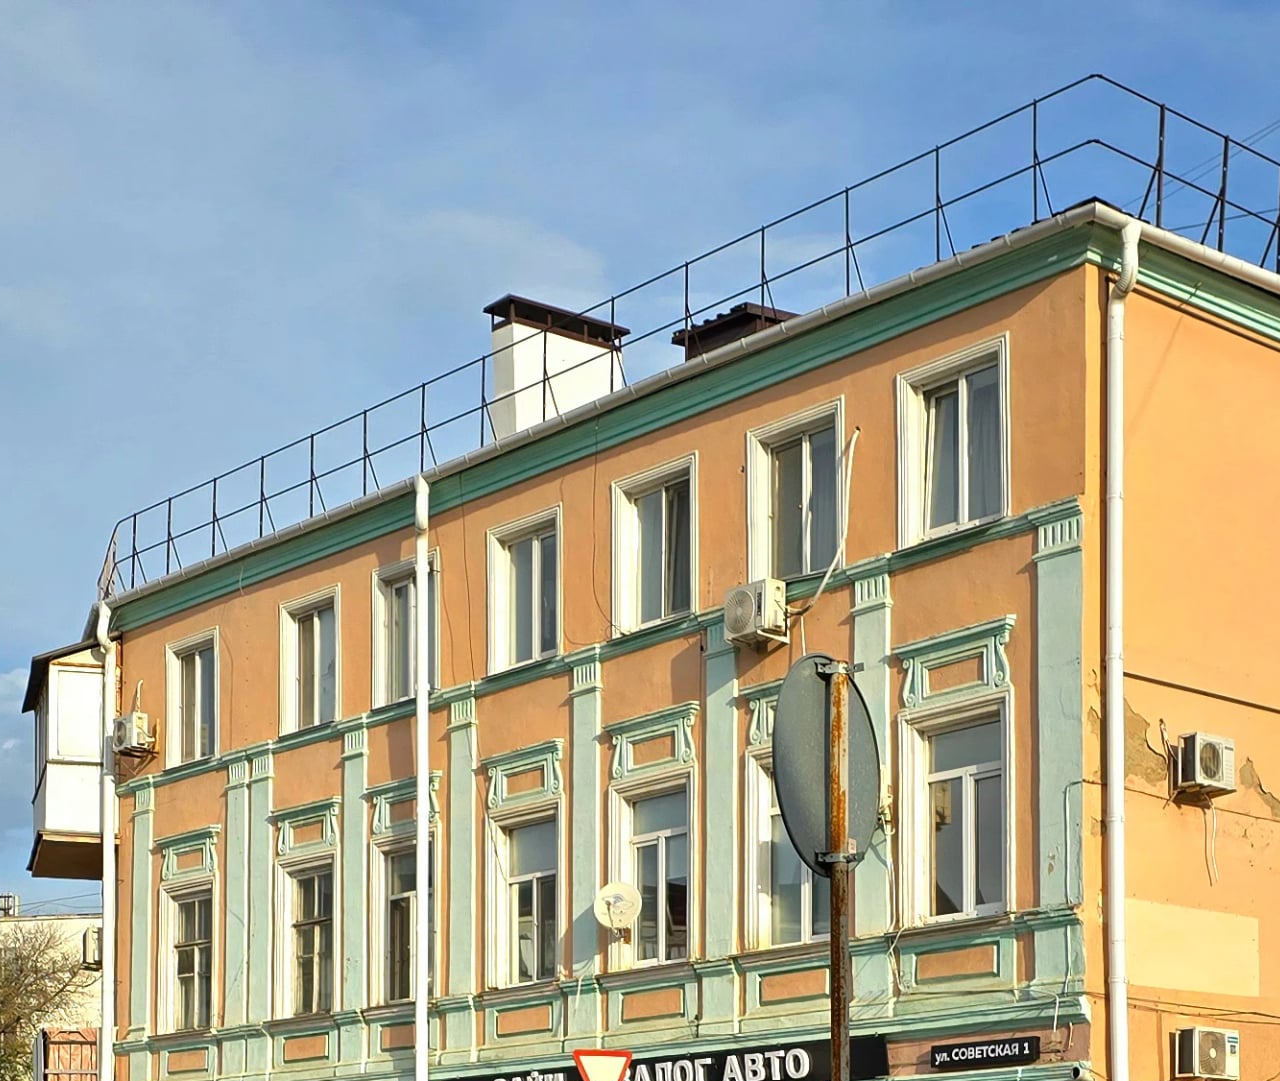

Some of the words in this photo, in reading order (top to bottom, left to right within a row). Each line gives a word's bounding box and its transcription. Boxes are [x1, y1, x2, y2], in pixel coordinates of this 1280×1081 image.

[935, 1052, 950, 1066] ул.
[951, 1042, 1019, 1061] СОВЕТСКАЯ
[1023, 1042, 1030, 1054] 1
